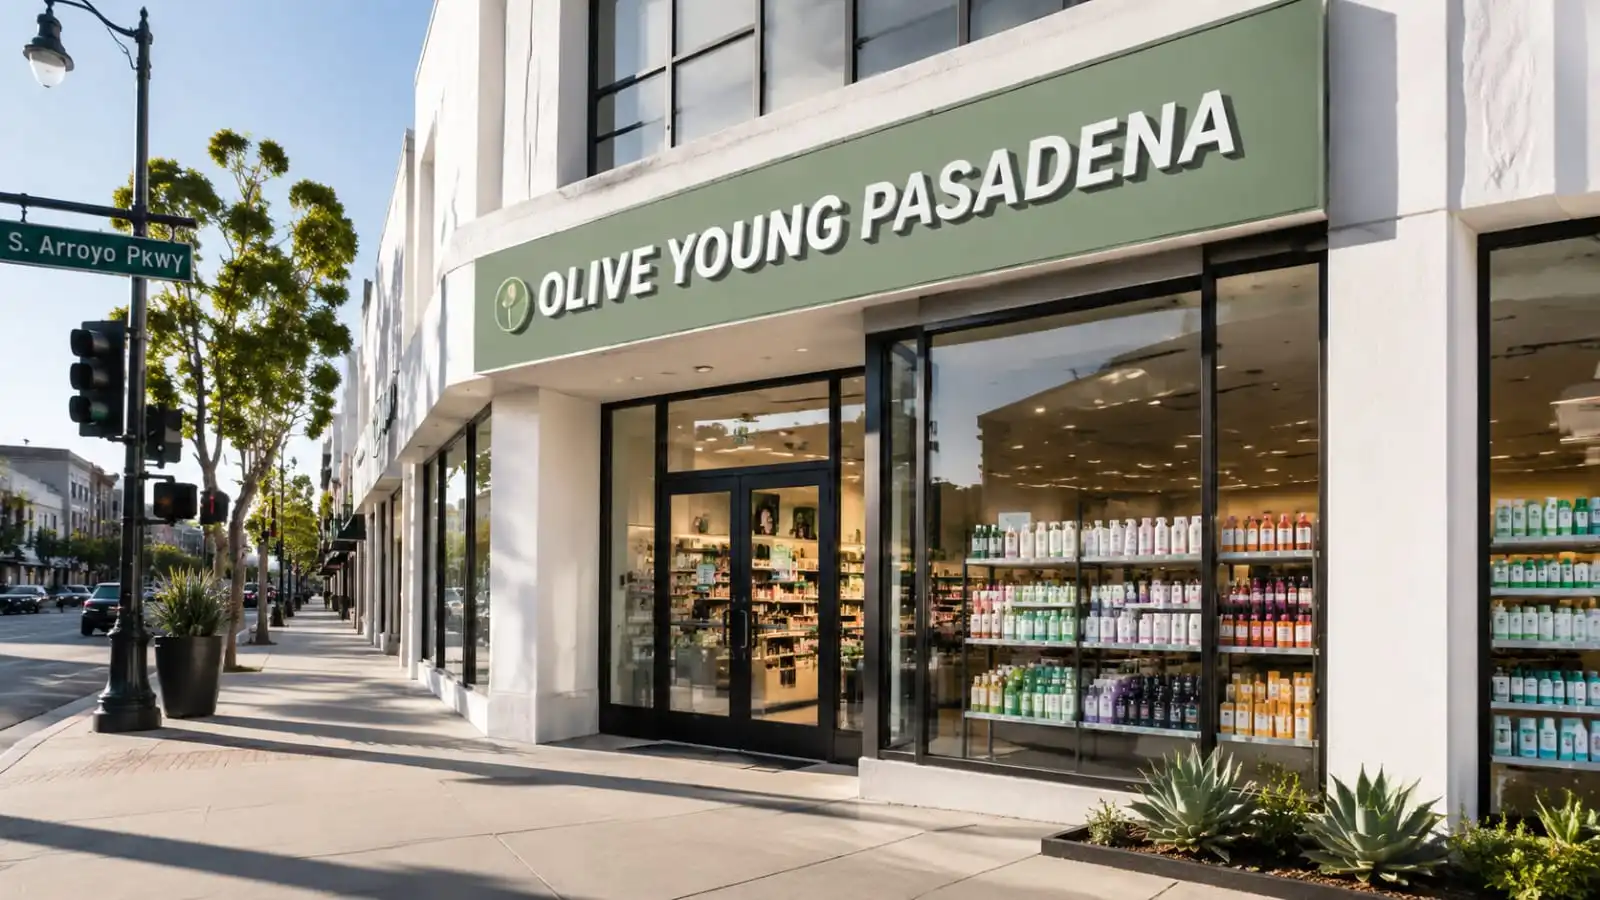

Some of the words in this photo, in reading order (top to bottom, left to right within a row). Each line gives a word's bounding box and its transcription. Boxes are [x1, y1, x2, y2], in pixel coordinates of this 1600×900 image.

[8, 232, 30, 253] S.
[39, 235, 116, 266] Arroyo
[538, 244, 656, 317] OLIVE
[668, 194, 844, 286] YOUNG
[860, 89, 1237, 241] PASADENA
